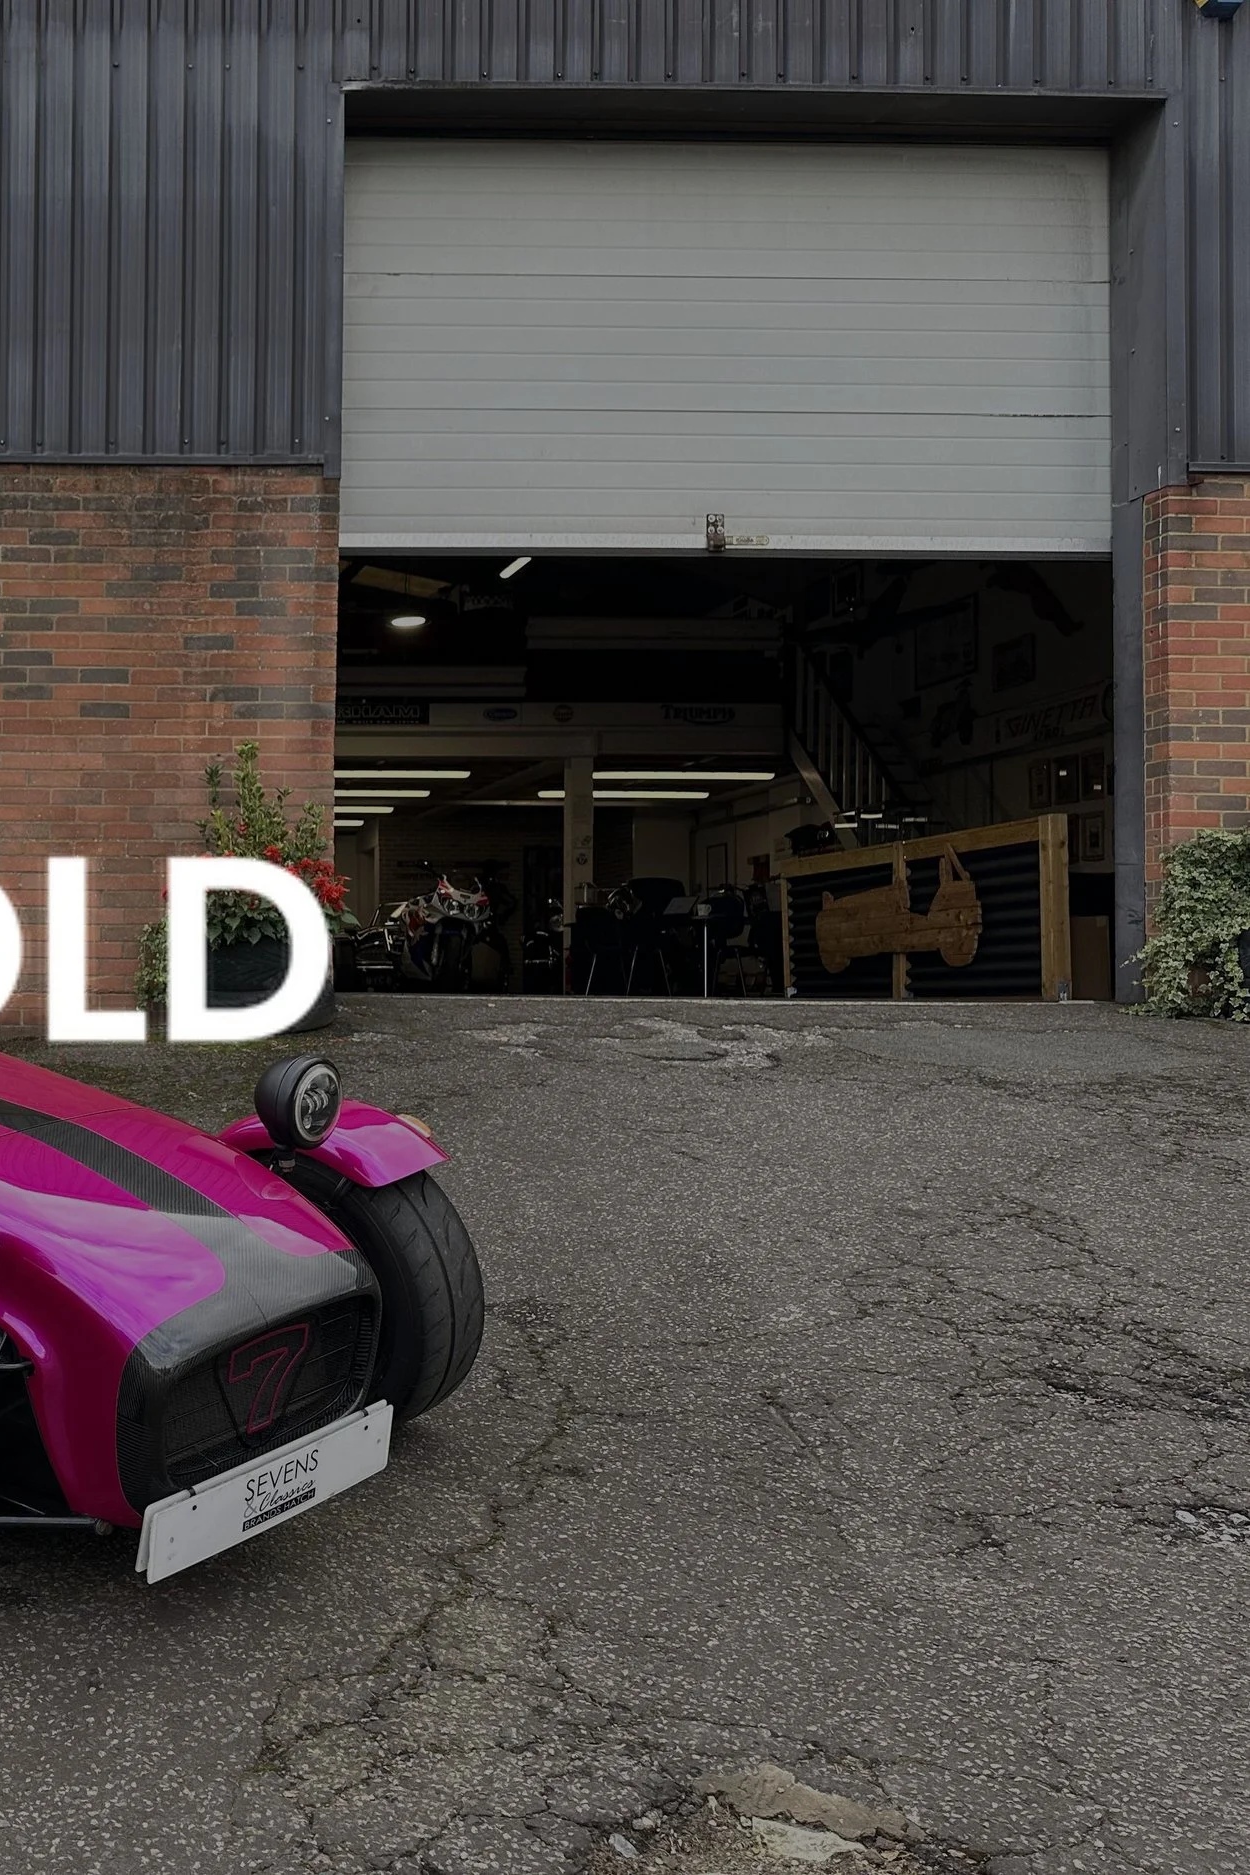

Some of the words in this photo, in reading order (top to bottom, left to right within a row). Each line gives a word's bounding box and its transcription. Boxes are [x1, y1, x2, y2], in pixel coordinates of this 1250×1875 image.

[228, 1323, 310, 1434] 7
[244, 1449, 319, 1502] SEVENS
[259, 1479, 315, 1512] Classics
[244, 1505, 282, 1531] BRANDS
[283, 1489, 315, 1511] HATCH
